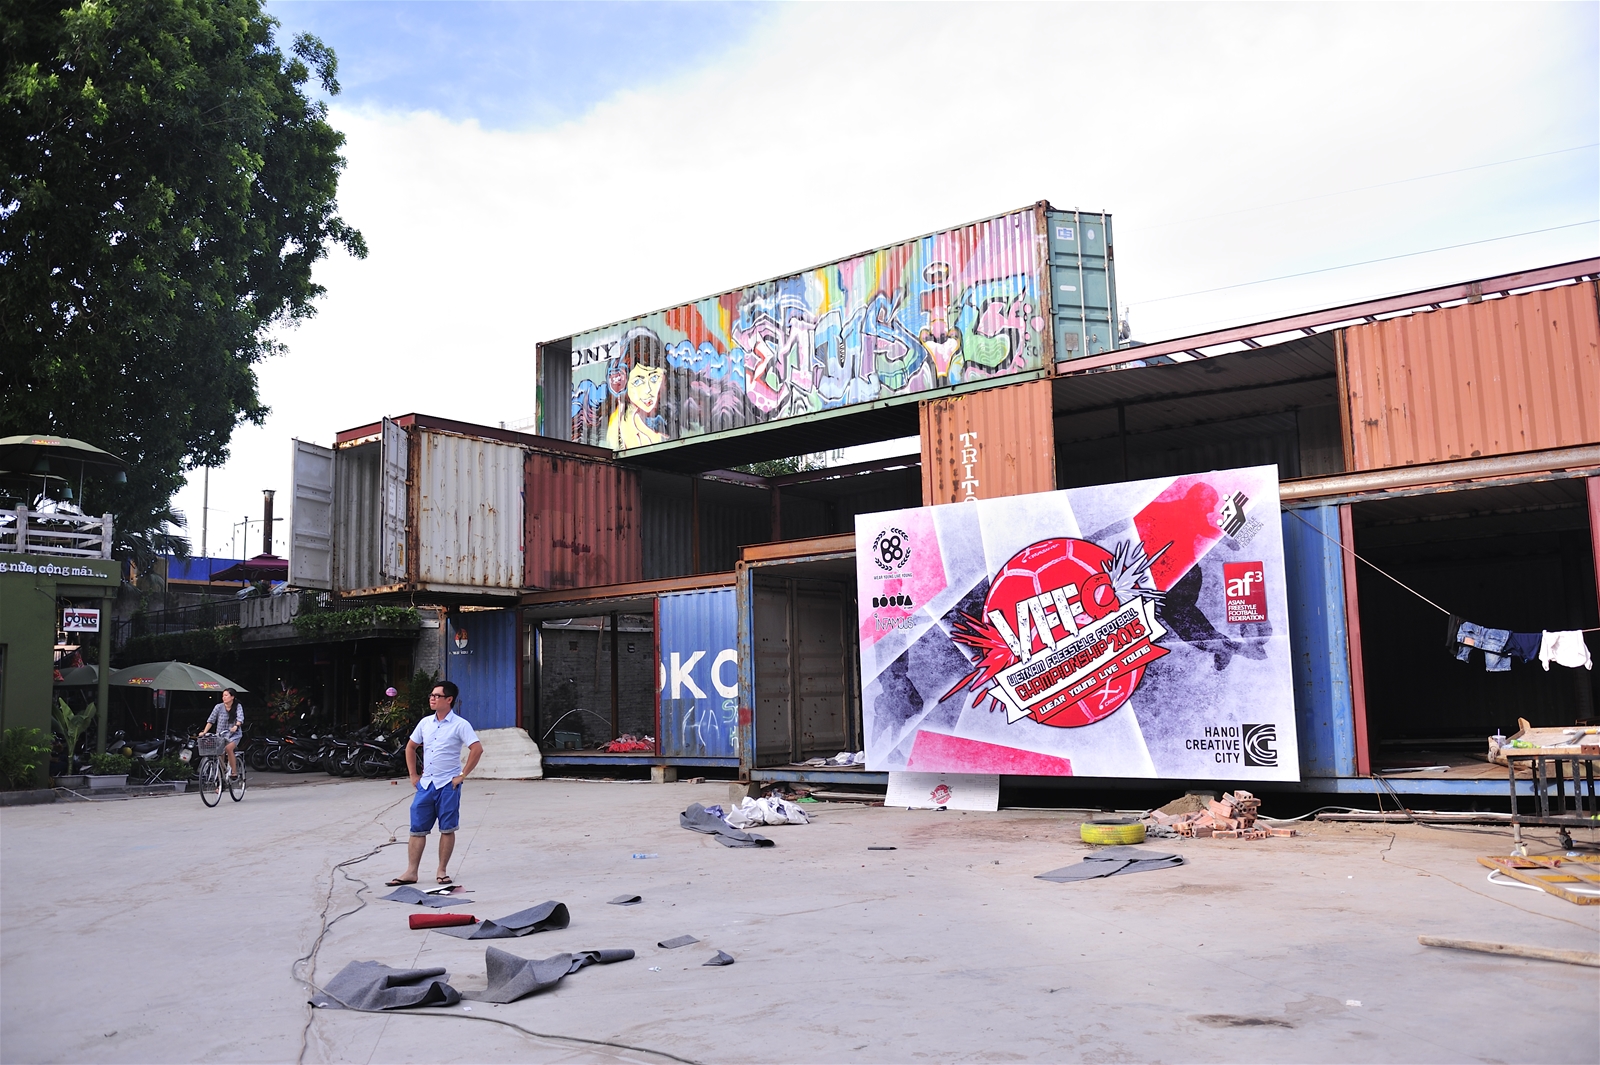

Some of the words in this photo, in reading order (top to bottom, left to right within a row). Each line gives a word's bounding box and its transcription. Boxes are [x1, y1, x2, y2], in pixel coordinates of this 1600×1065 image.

[39, 563, 70, 577] cộng
[1007, 658, 1046, 687] VIETNAM
[1046, 634, 1096, 668] FREESTYLE
[1095, 608, 1139, 640] FOOTBALL
[1014, 638, 1109, 702] CHAMPIONSHIP
[1107, 617, 1146, 653] 2015
[1039, 695, 1067, 715] WEAR
[1068, 676, 1097, 698] YOUNG
[1099, 663, 1119, 680] LIVE
[1121, 645, 1151, 666] YOUNG
[1204, 726, 1240, 738] HANOI
[1185, 739, 1240, 751] CREATIVE
[1215, 752, 1240, 764] CITY
